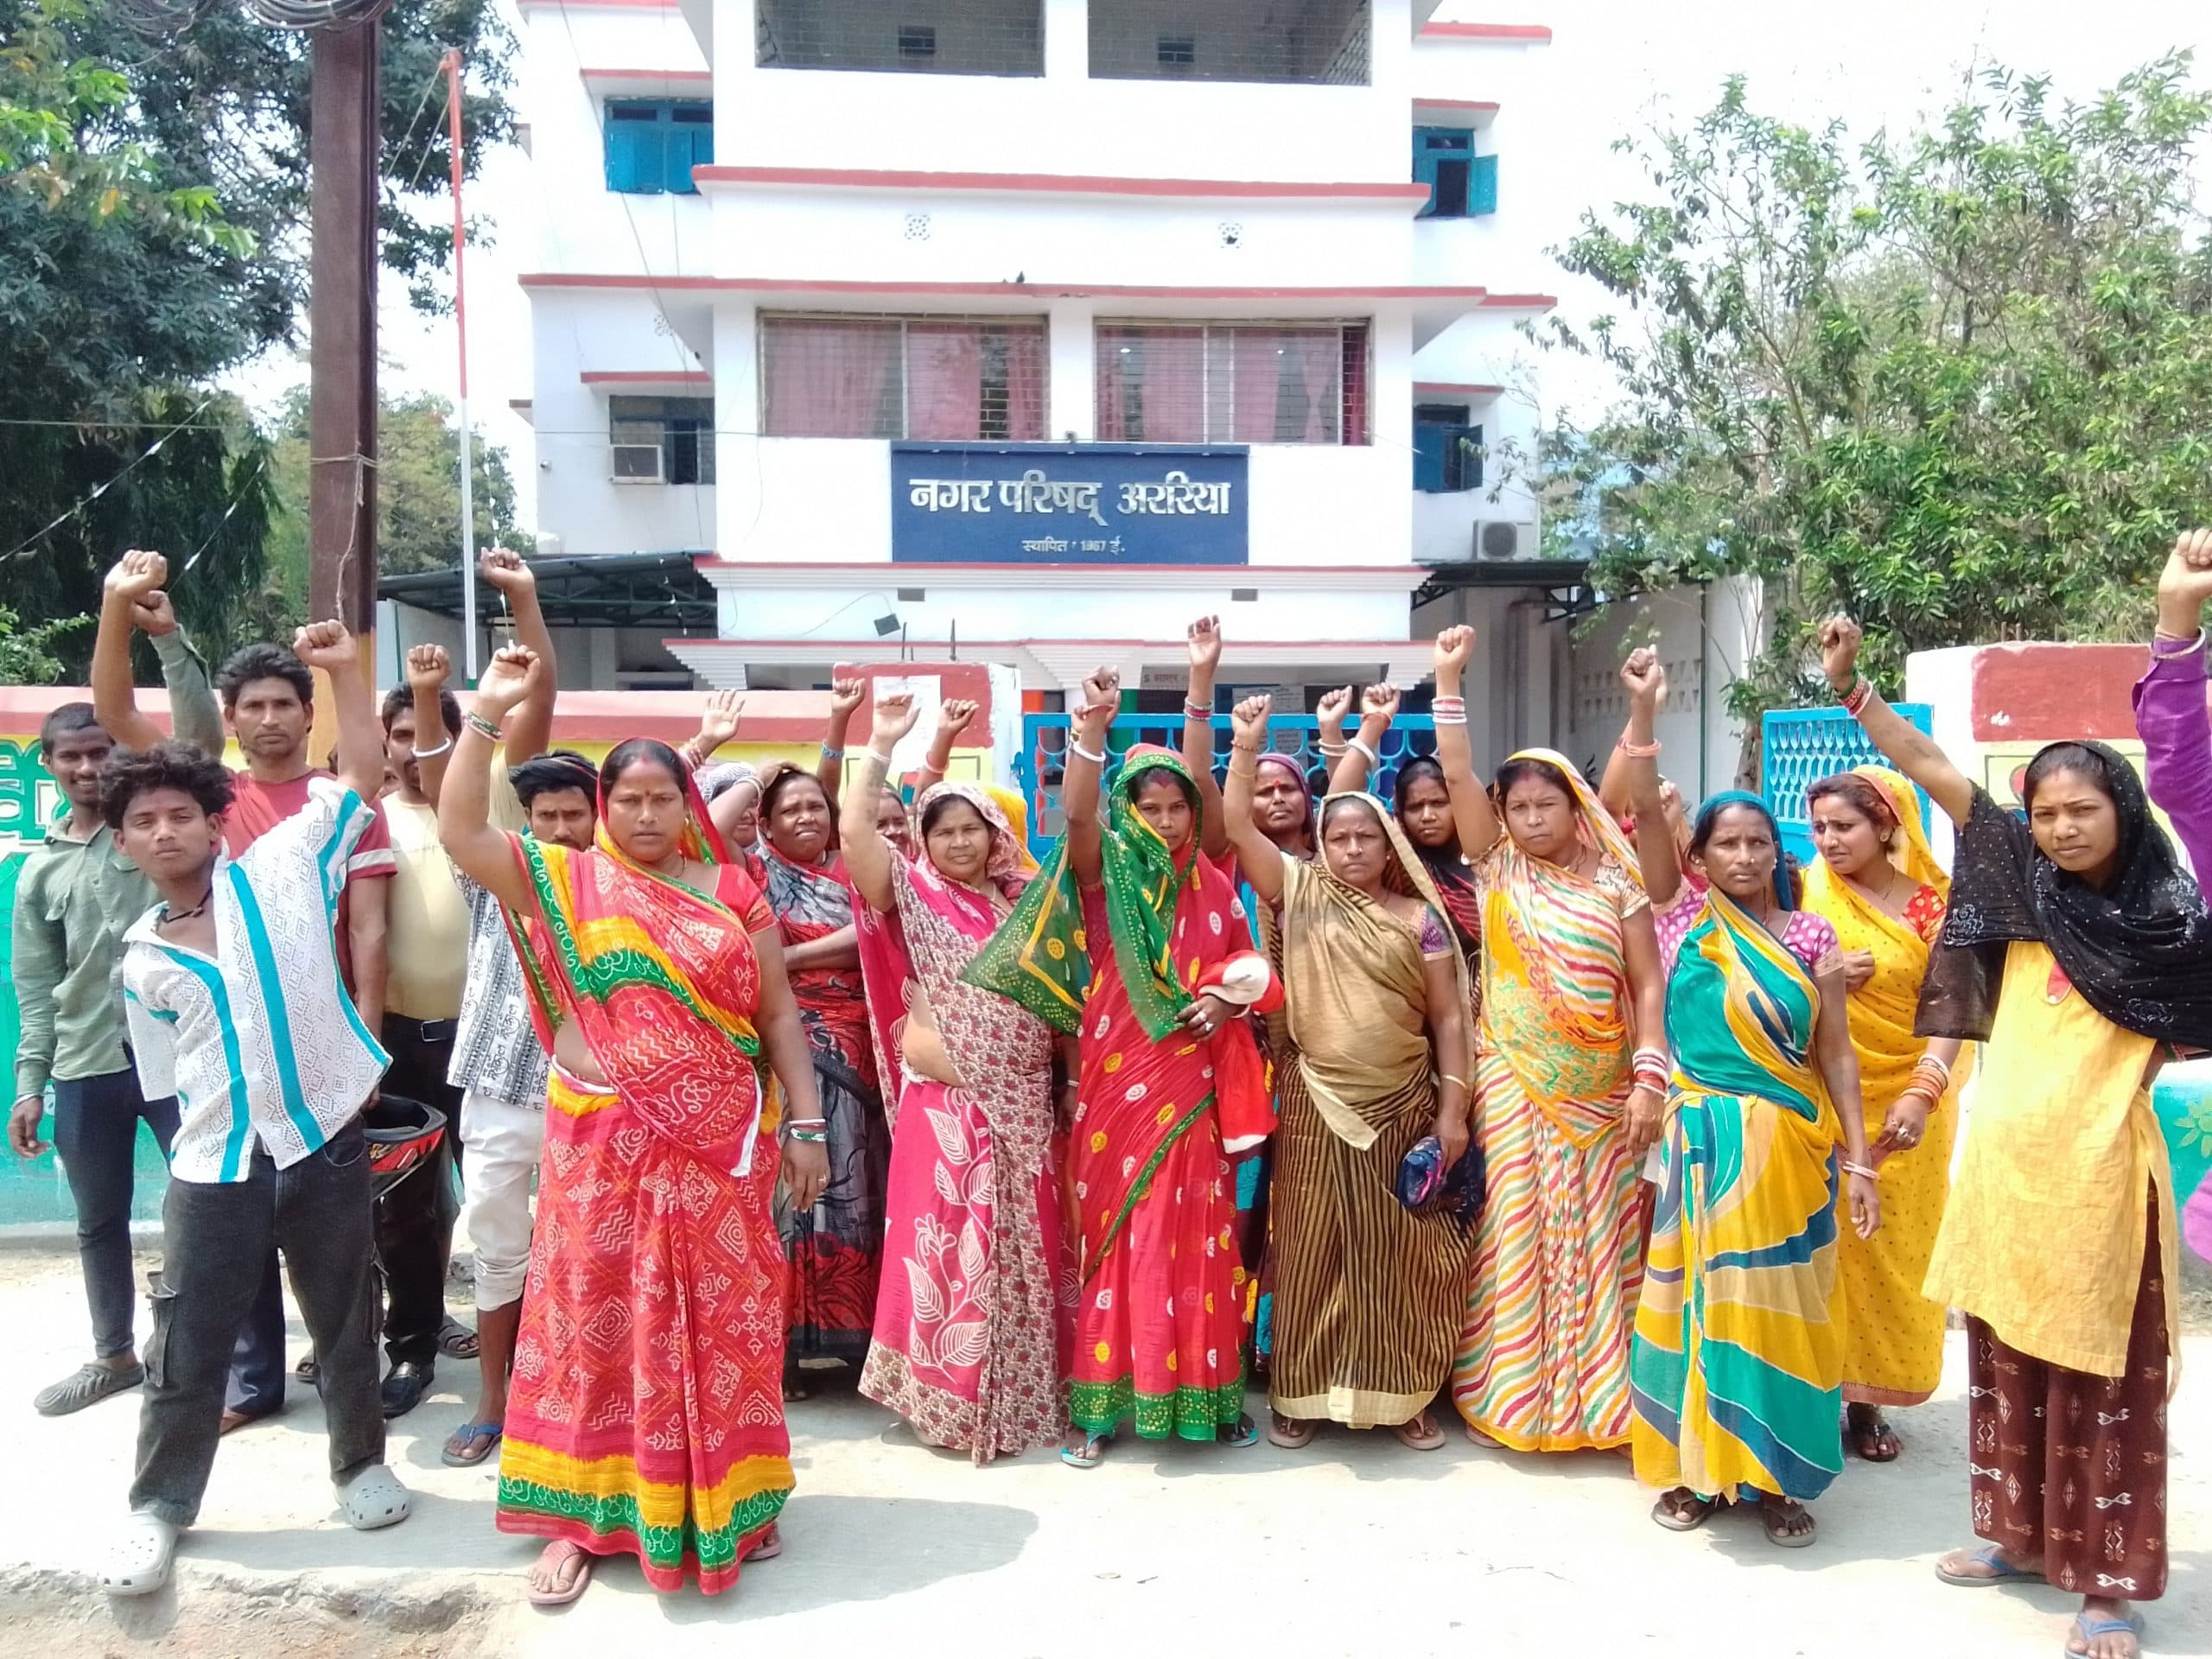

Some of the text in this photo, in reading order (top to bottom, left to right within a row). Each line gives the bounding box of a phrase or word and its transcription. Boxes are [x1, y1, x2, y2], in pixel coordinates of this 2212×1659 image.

[909, 469, 1231, 526] नगर परिषद् अररिया
[1021, 536, 1069, 552] स्थापित
